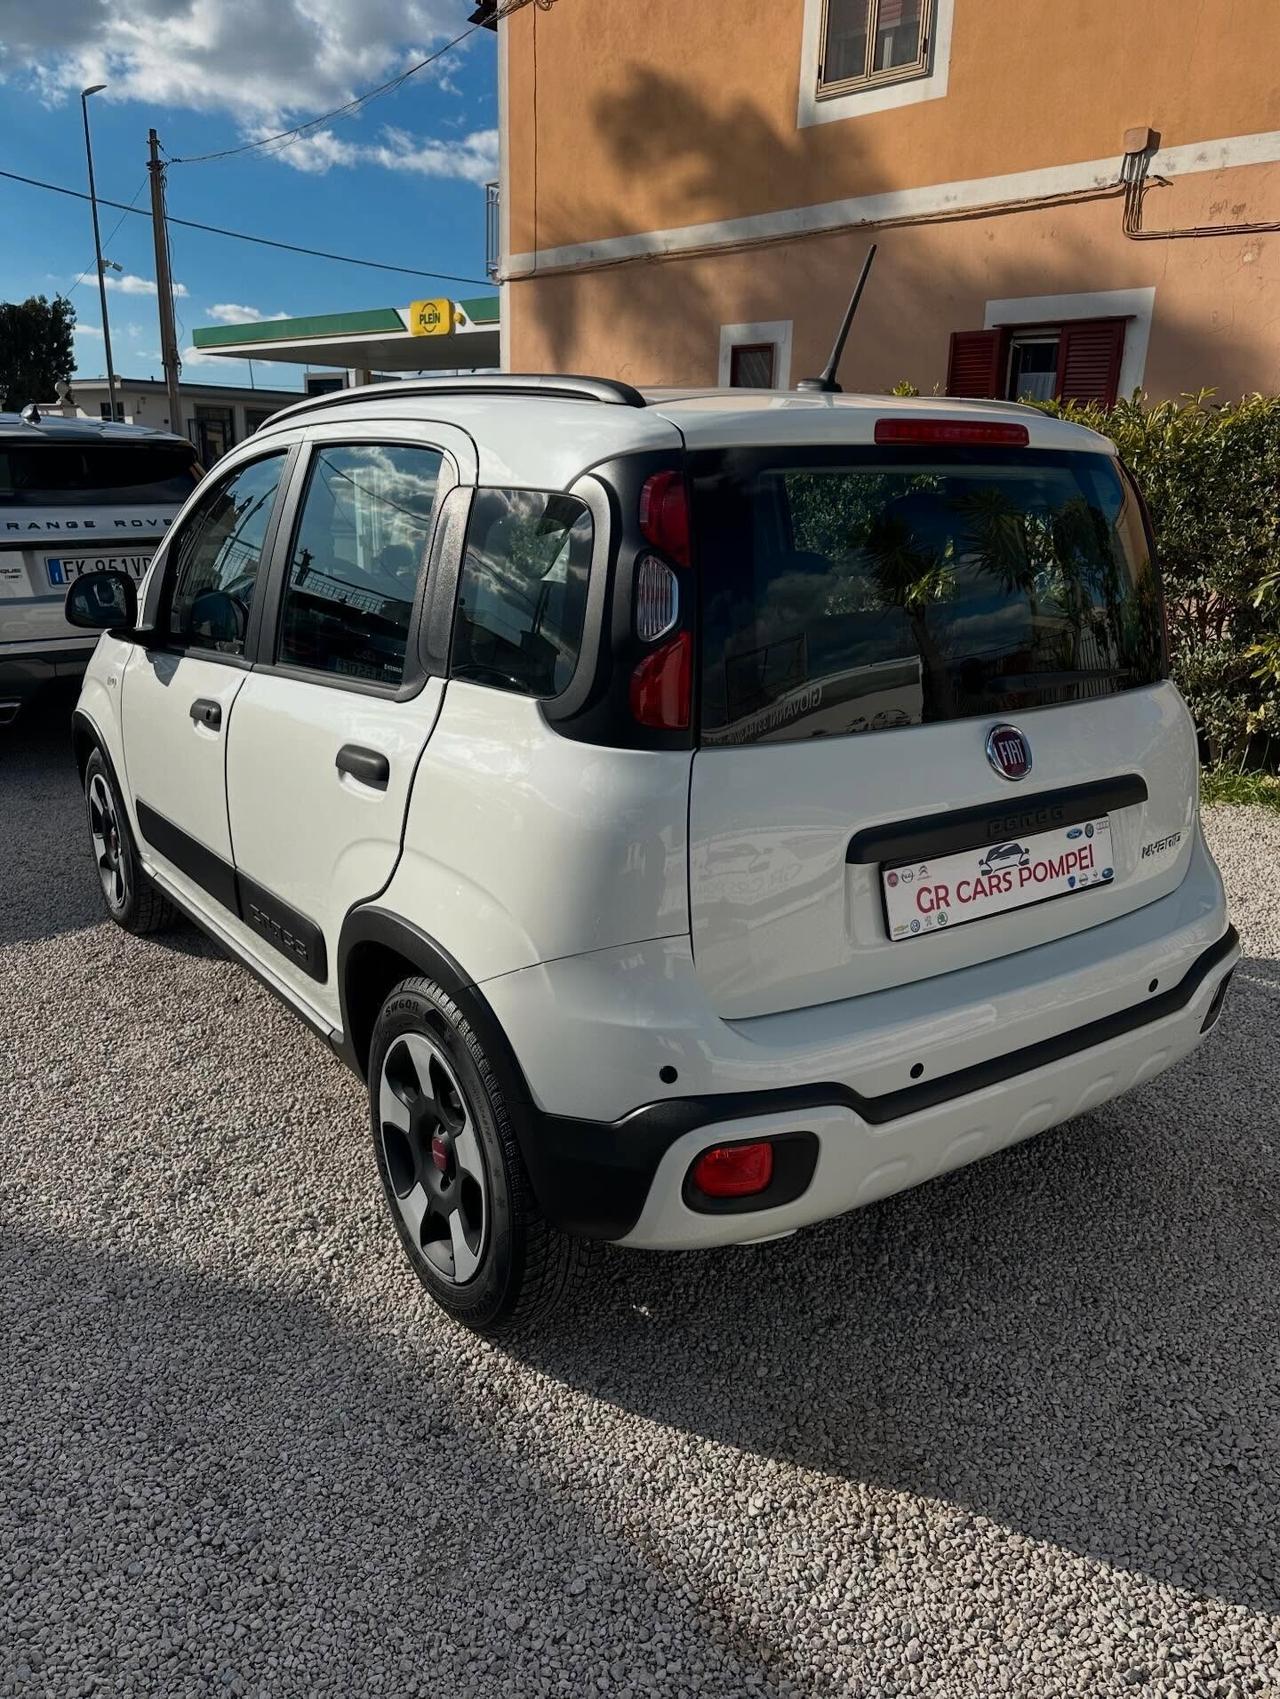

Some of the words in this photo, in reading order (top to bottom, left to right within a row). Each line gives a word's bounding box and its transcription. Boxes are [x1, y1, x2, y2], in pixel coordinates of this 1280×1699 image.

[6, 520, 96, 530] RANGE
[114, 519, 173, 528] ROVE
[62, 559, 85, 581] FK
[998, 739, 1024, 766] FIAT
[916, 884, 951, 914] GR
[956, 871, 1013, 904] CARS
[1018, 843, 1094, 888] POMPEI
